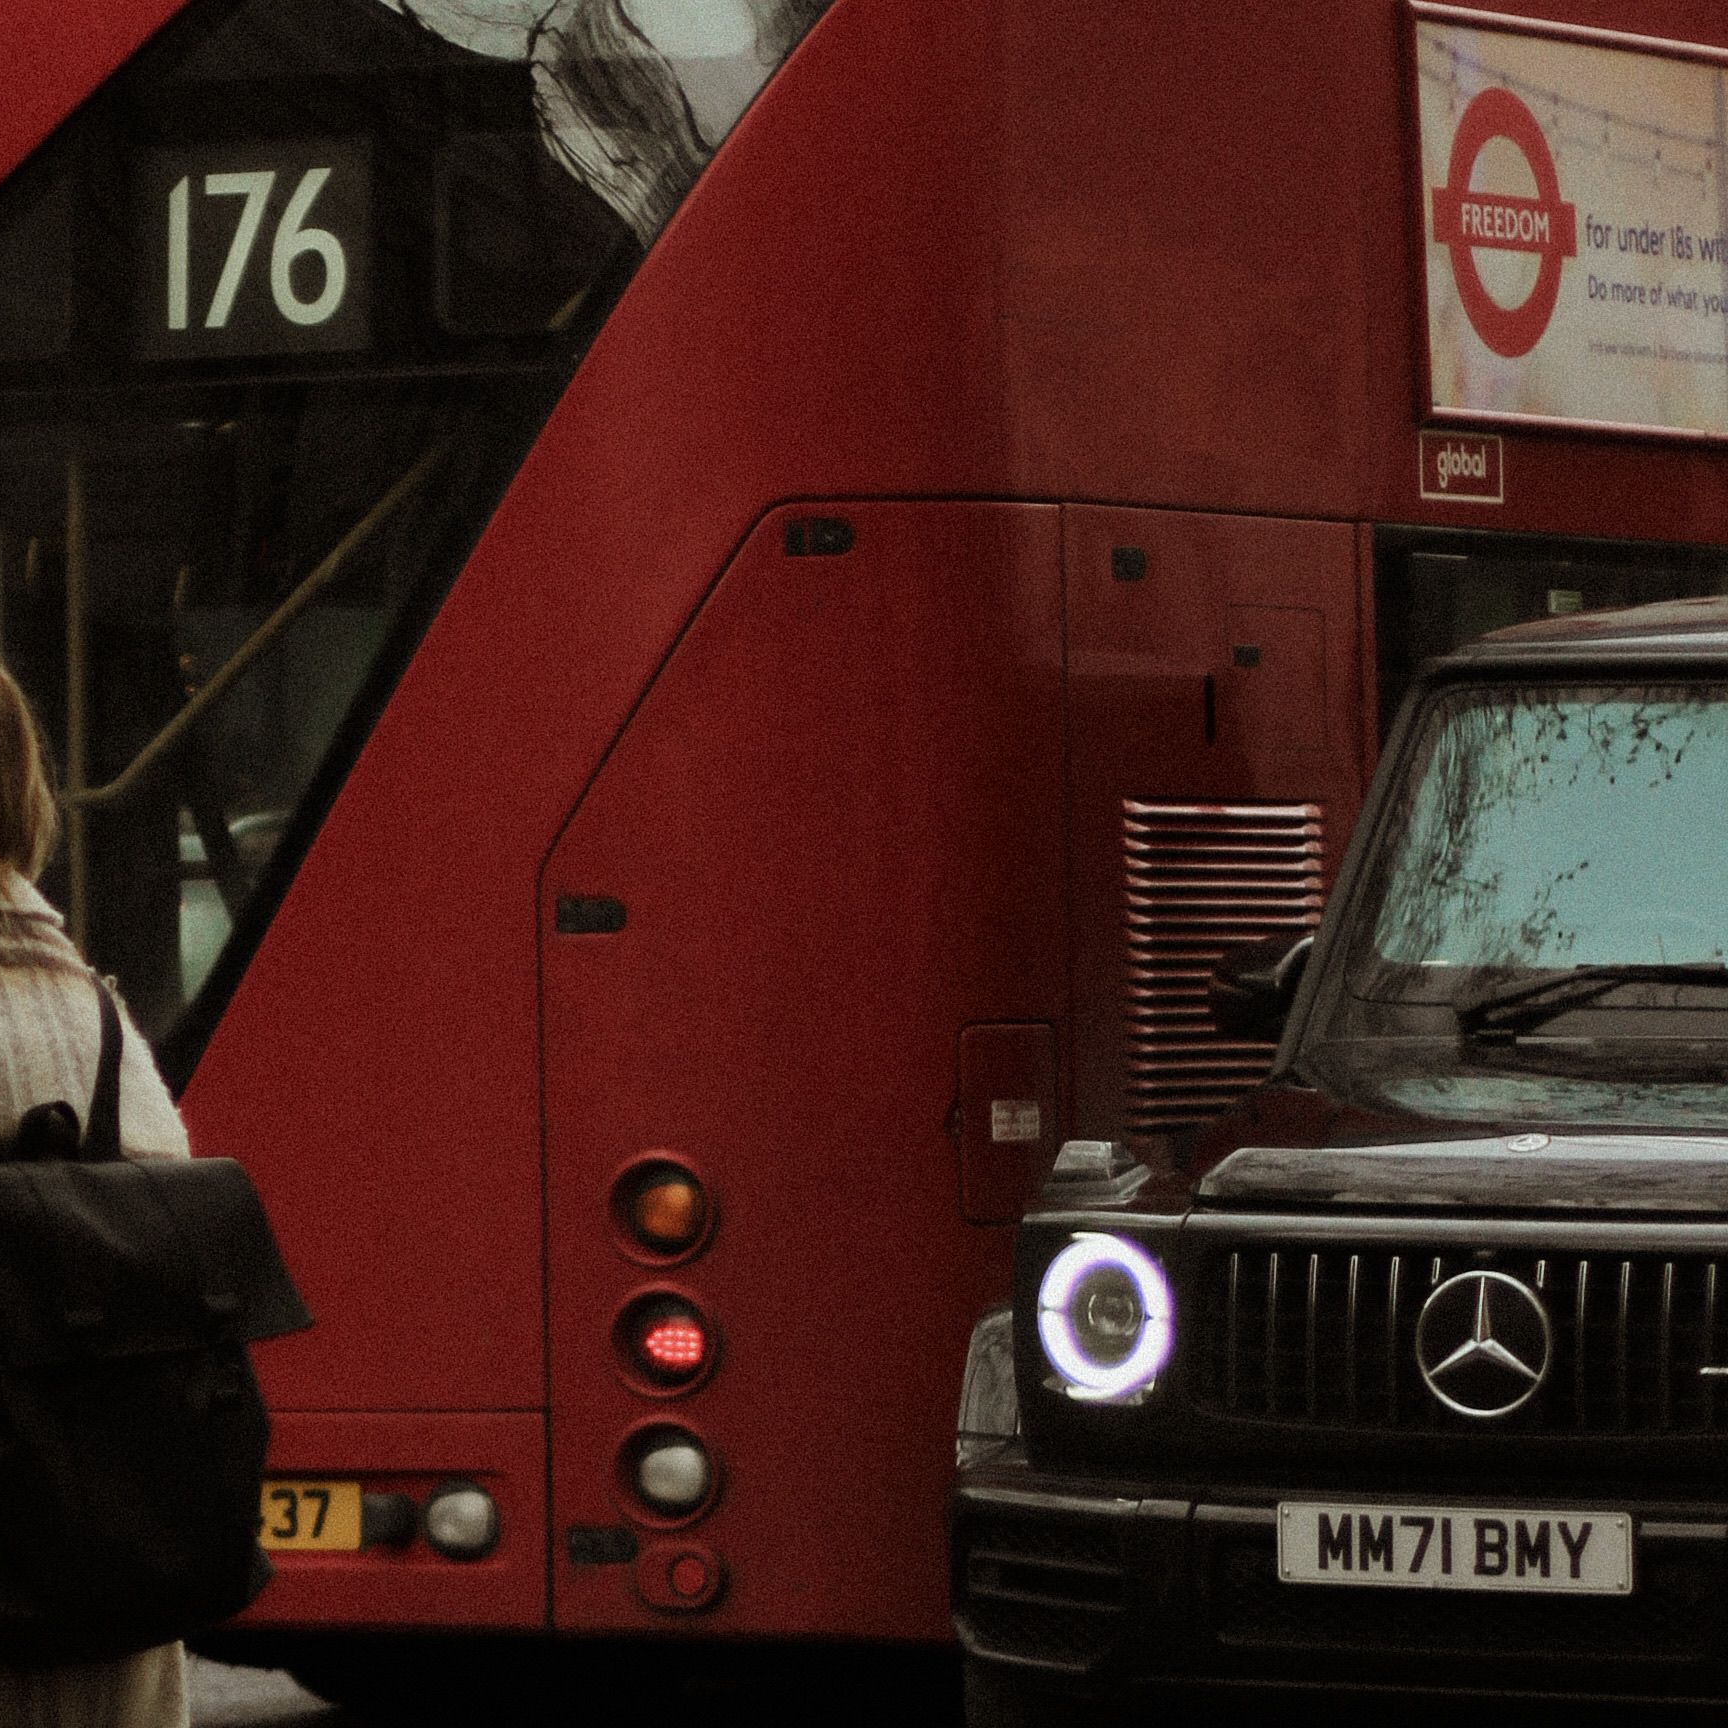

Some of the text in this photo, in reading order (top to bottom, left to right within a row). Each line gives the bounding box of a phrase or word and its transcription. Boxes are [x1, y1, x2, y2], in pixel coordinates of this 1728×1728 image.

[1460, 201, 1551, 245] FREEDOM
[1585, 214, 1612, 249] for
[1618, 223, 1667, 257] under
[1670, 225, 1694, 261] 18s
[166, 167, 347, 330] 176
[1587, 273, 1608, 301] Do
[1611, 281, 1647, 305] more
[1649, 281, 1663, 306] of
[1666, 285, 1698, 311] what
[1435, 444, 1487, 488] global
[260, 1487, 331, 1539] 37
[1318, 1512, 1593, 1580] MM71 BMY
